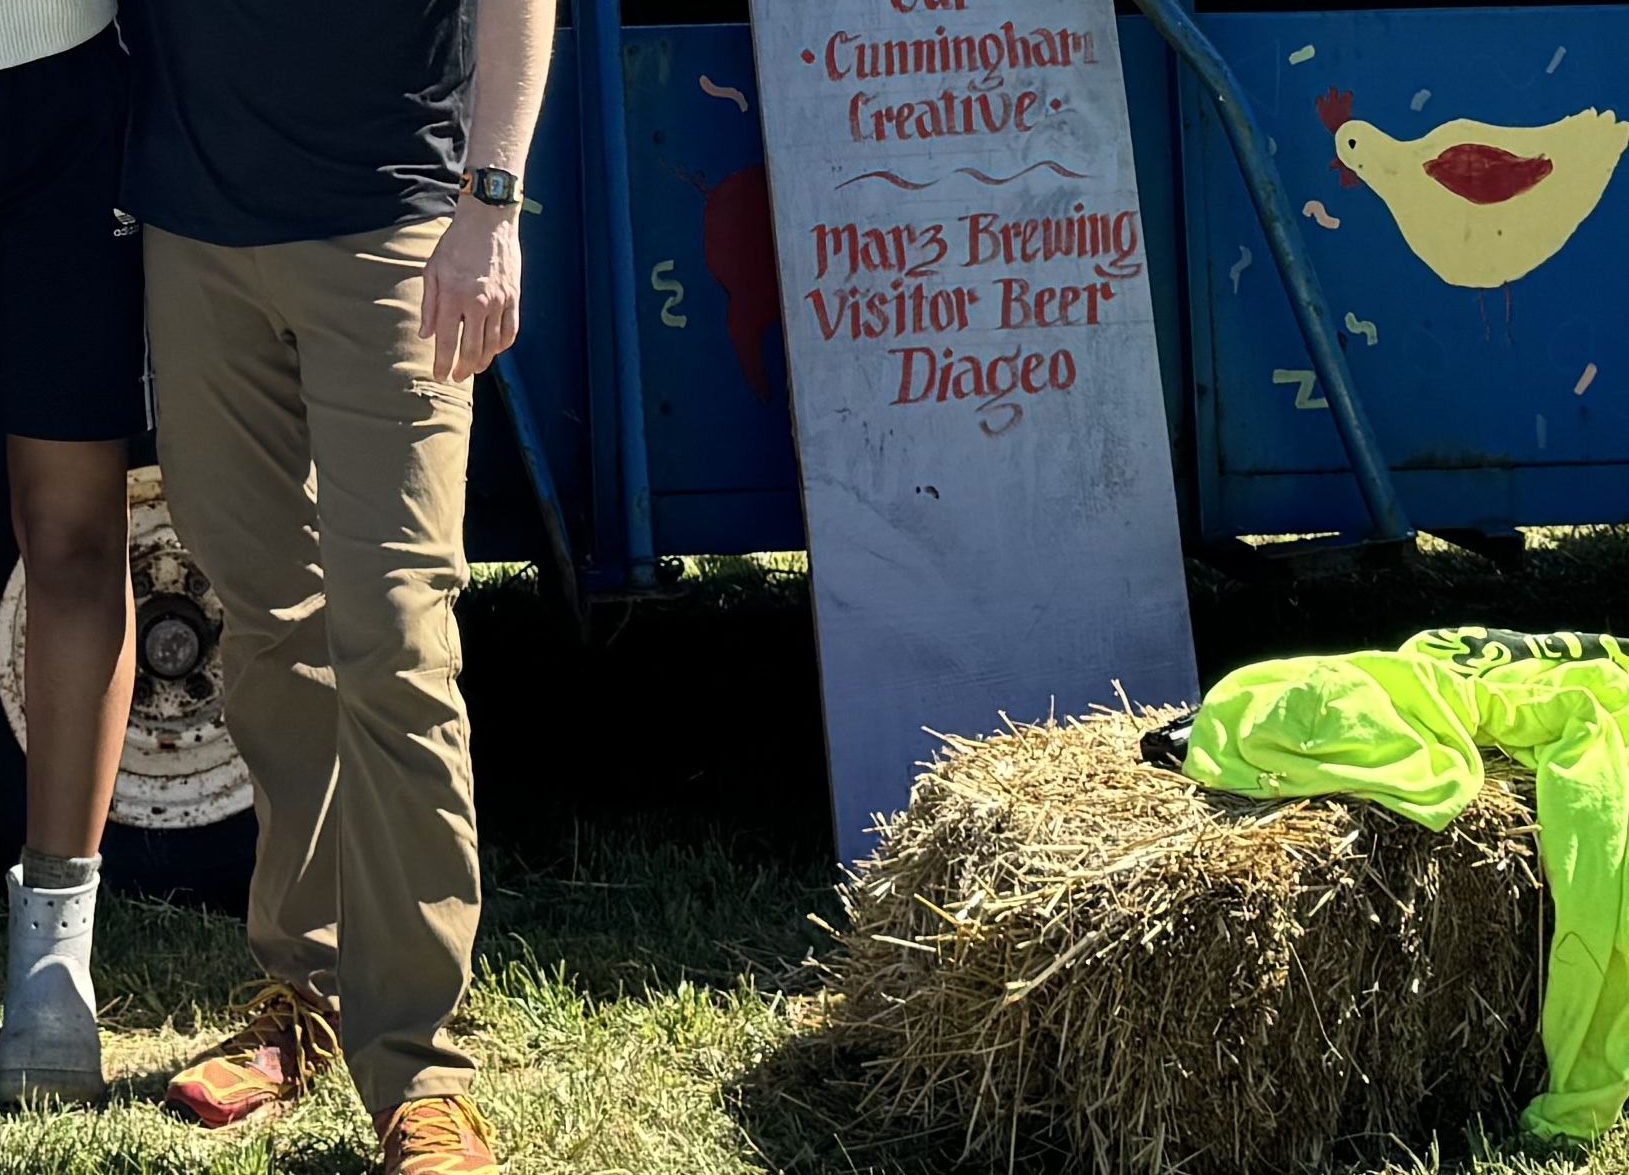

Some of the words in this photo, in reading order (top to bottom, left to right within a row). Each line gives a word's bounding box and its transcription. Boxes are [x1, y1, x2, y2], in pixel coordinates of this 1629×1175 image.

[825, 21, 1100, 92] Cunningham
[849, 90, 1038, 142] Creative
[810, 222, 949, 281] Marz
[957, 202, 1143, 279] Brewing
[803, 277, 979, 341] Visitor
[992, 278, 1117, 331] Beer
[888, 345, 1077, 438] Diageo
